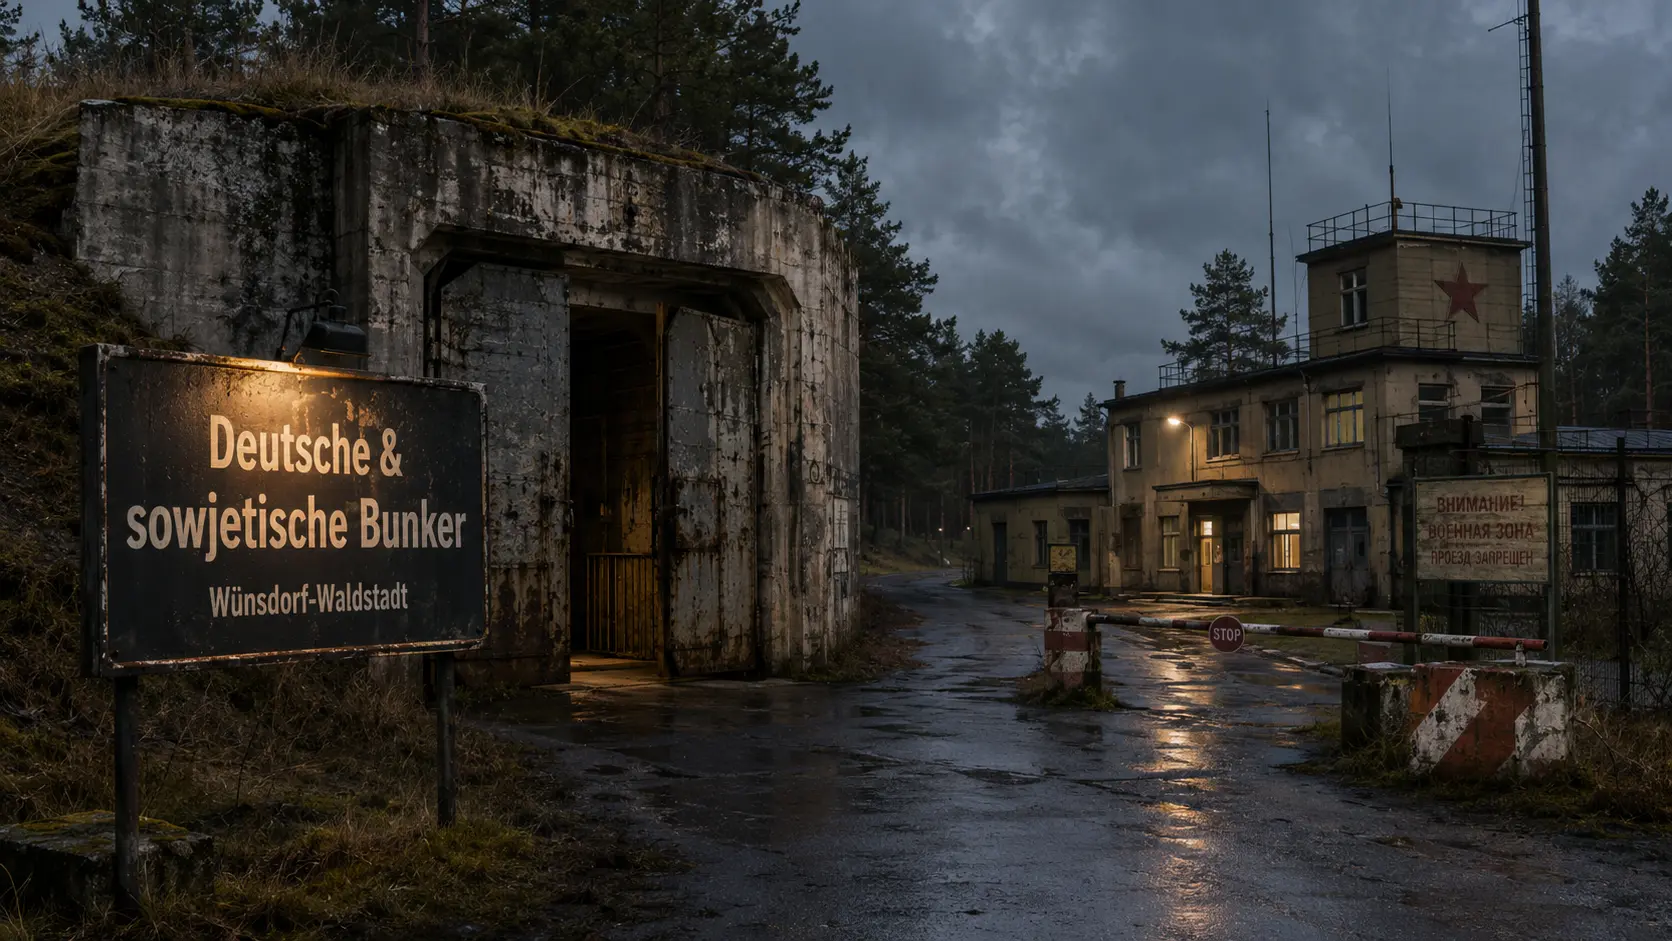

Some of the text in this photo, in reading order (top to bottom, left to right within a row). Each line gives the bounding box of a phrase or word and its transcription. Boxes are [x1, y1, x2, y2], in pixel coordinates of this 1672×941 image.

[210, 414, 403, 477] Deutsche &
[1437, 494, 1525, 513] ВНИМАНИЕ!
[126, 491, 467, 562] sowjetische Bunker
[1428, 522, 1535, 540] ВОЕННАЯ ЗОНА
[209, 581, 409, 618] Wünsdorf-Waldstadt
[1213, 627, 1241, 642] STOP
